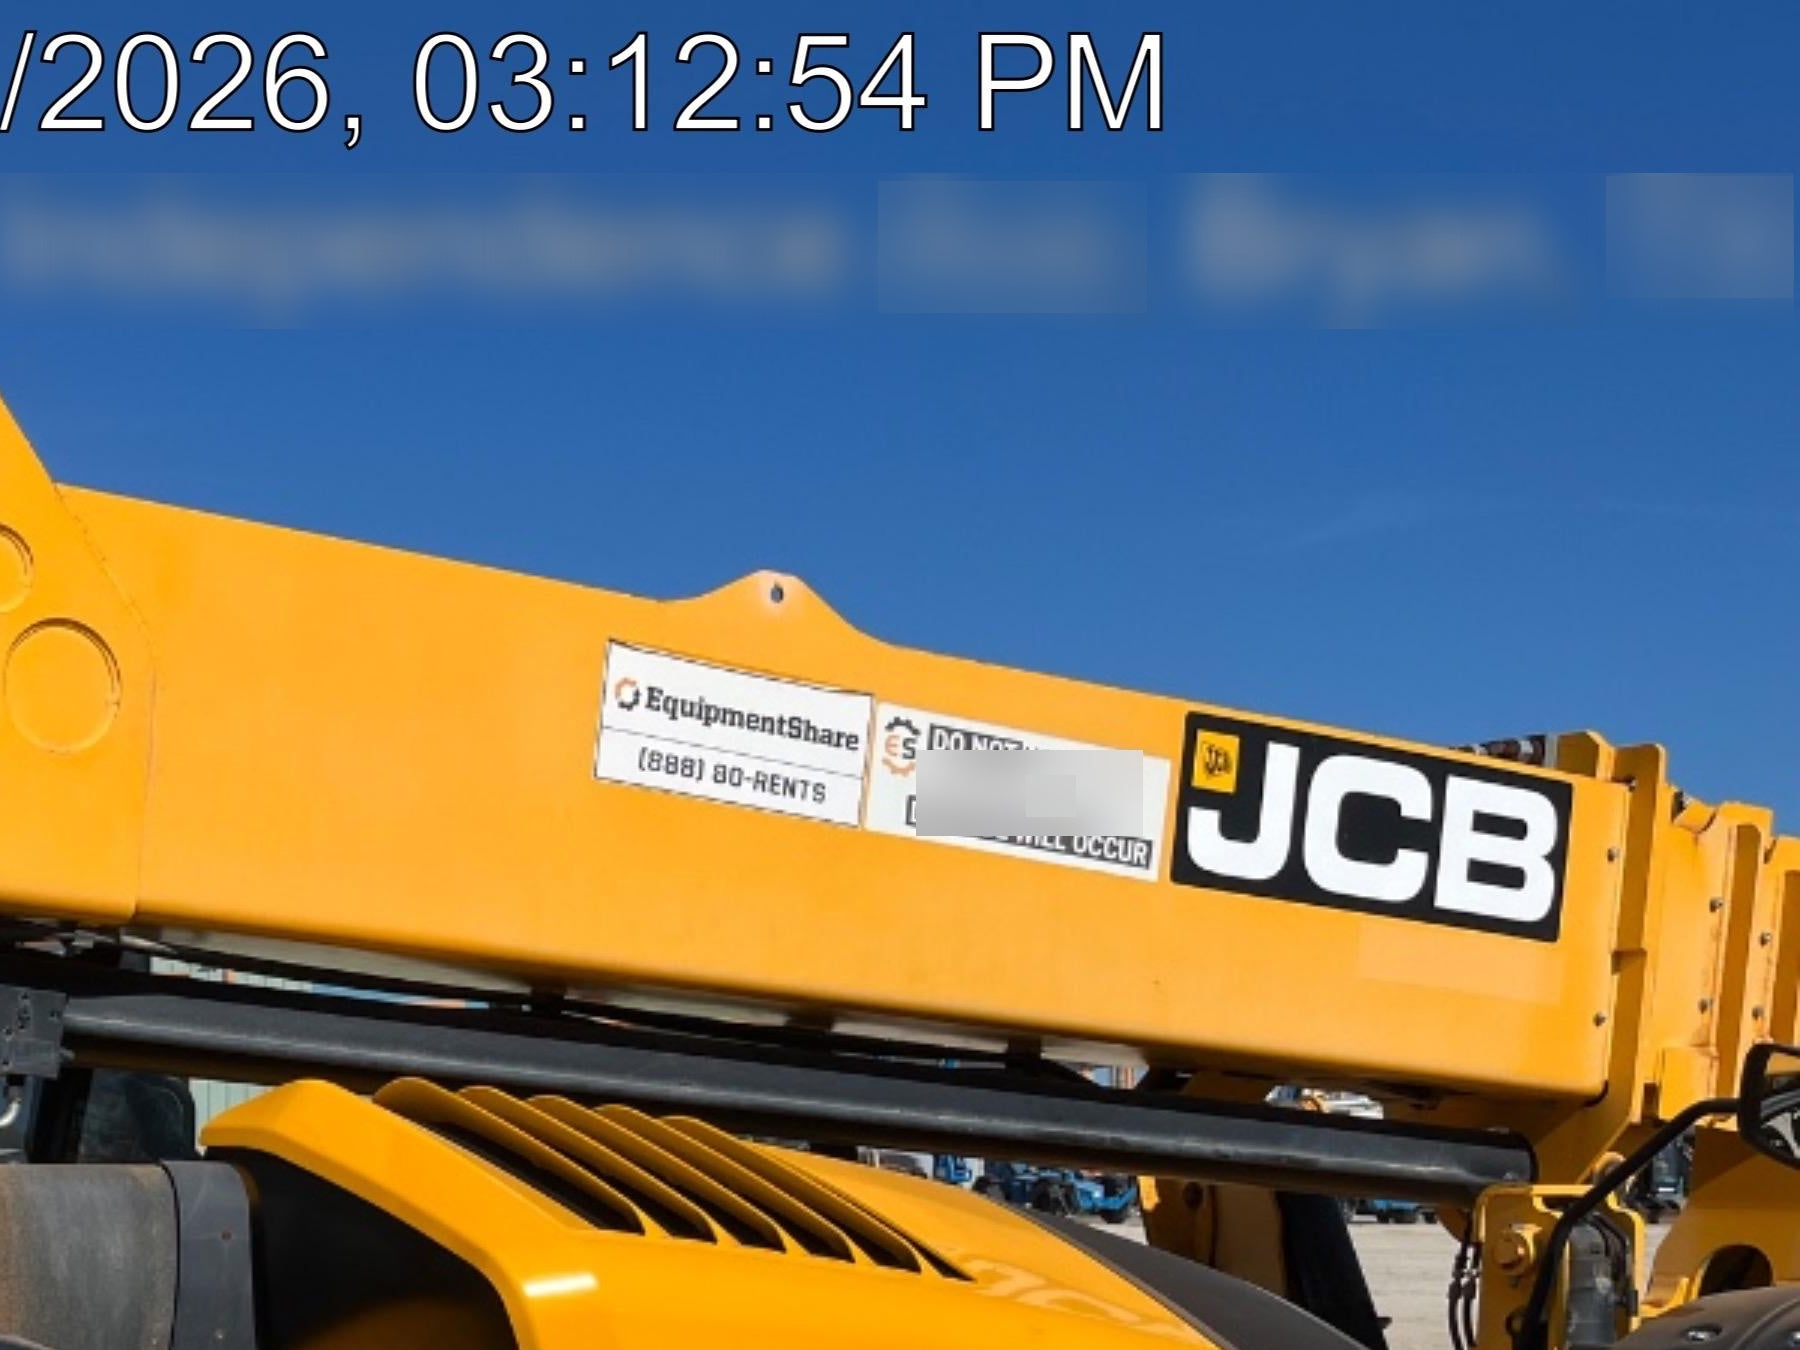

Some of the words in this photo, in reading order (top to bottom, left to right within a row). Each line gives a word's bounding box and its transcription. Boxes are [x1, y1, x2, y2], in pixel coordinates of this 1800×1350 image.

[645, 686, 859, 751] EquipmentShare
[933, 728, 965, 750] DO
[638, 747, 704, 781] (888)
[713, 764, 827, 804] 80-RENTS
[1073, 836, 1148, 866] OCCUR
[1187, 740, 1558, 923] JCB
